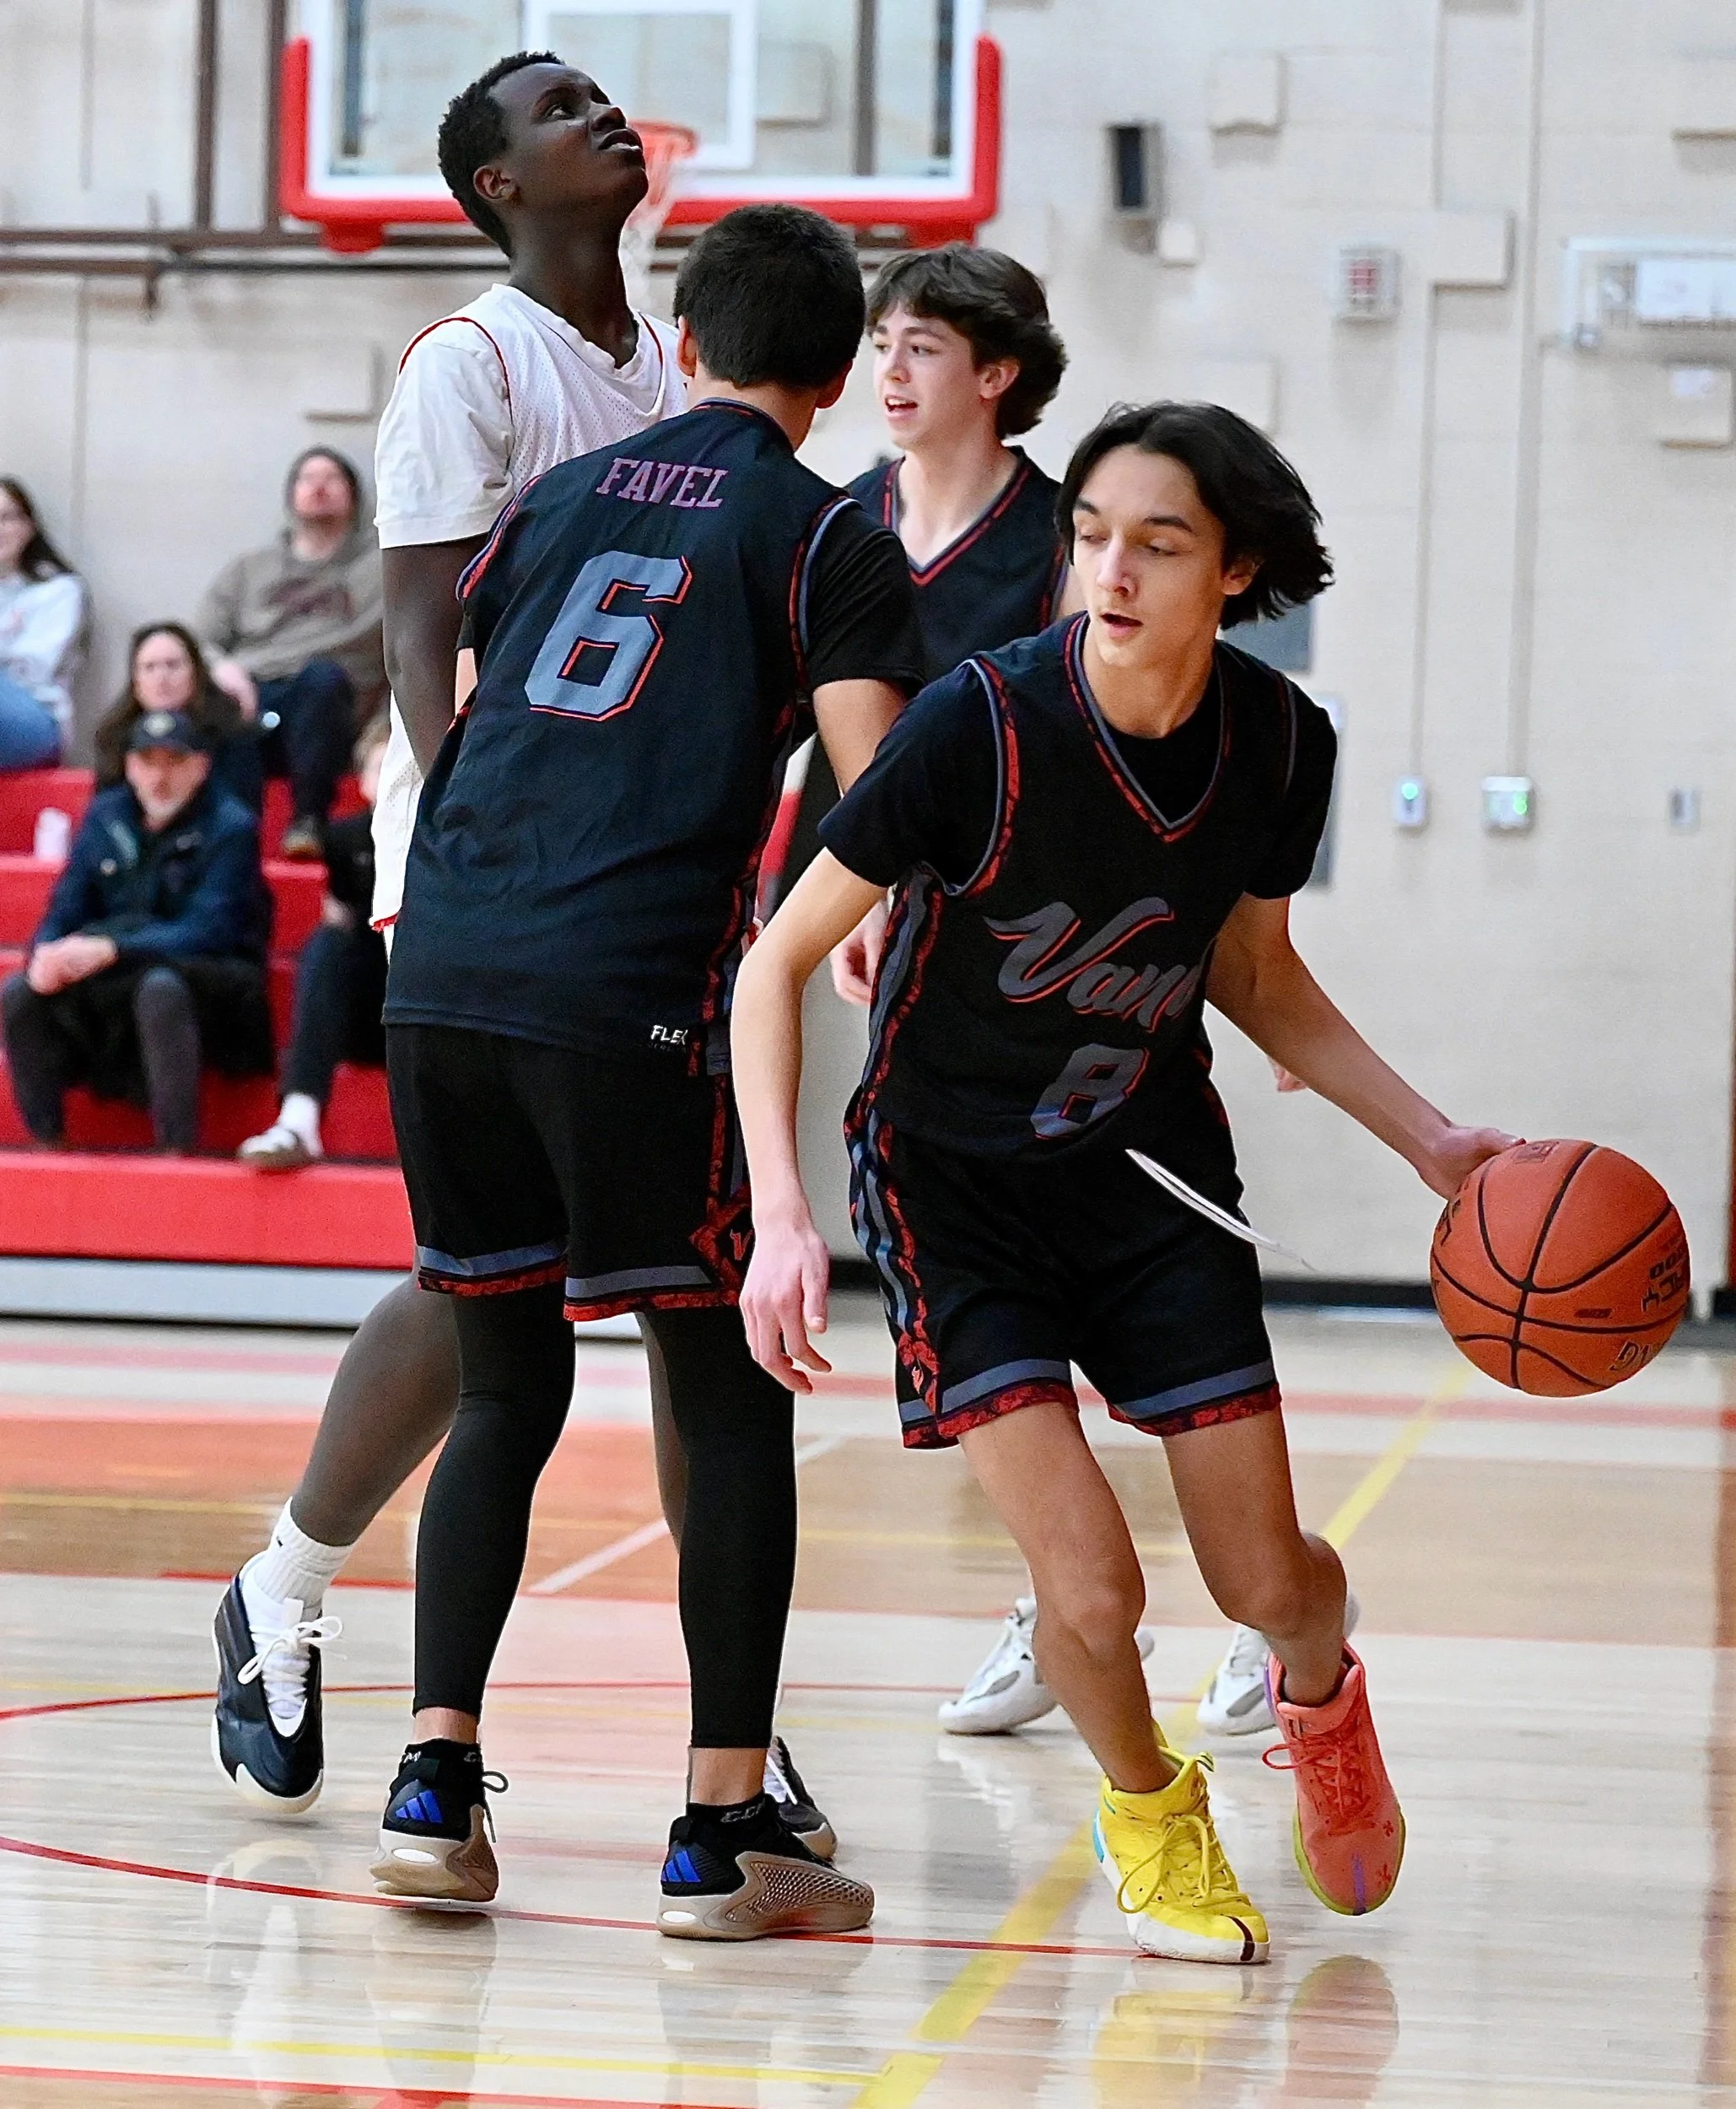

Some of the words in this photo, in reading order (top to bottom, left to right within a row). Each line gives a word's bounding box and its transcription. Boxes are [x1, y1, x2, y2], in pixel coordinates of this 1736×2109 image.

[596, 456, 729, 508] FAVEL
[524, 550, 693, 722] 6
[1029, 1042, 1151, 1140] 8
